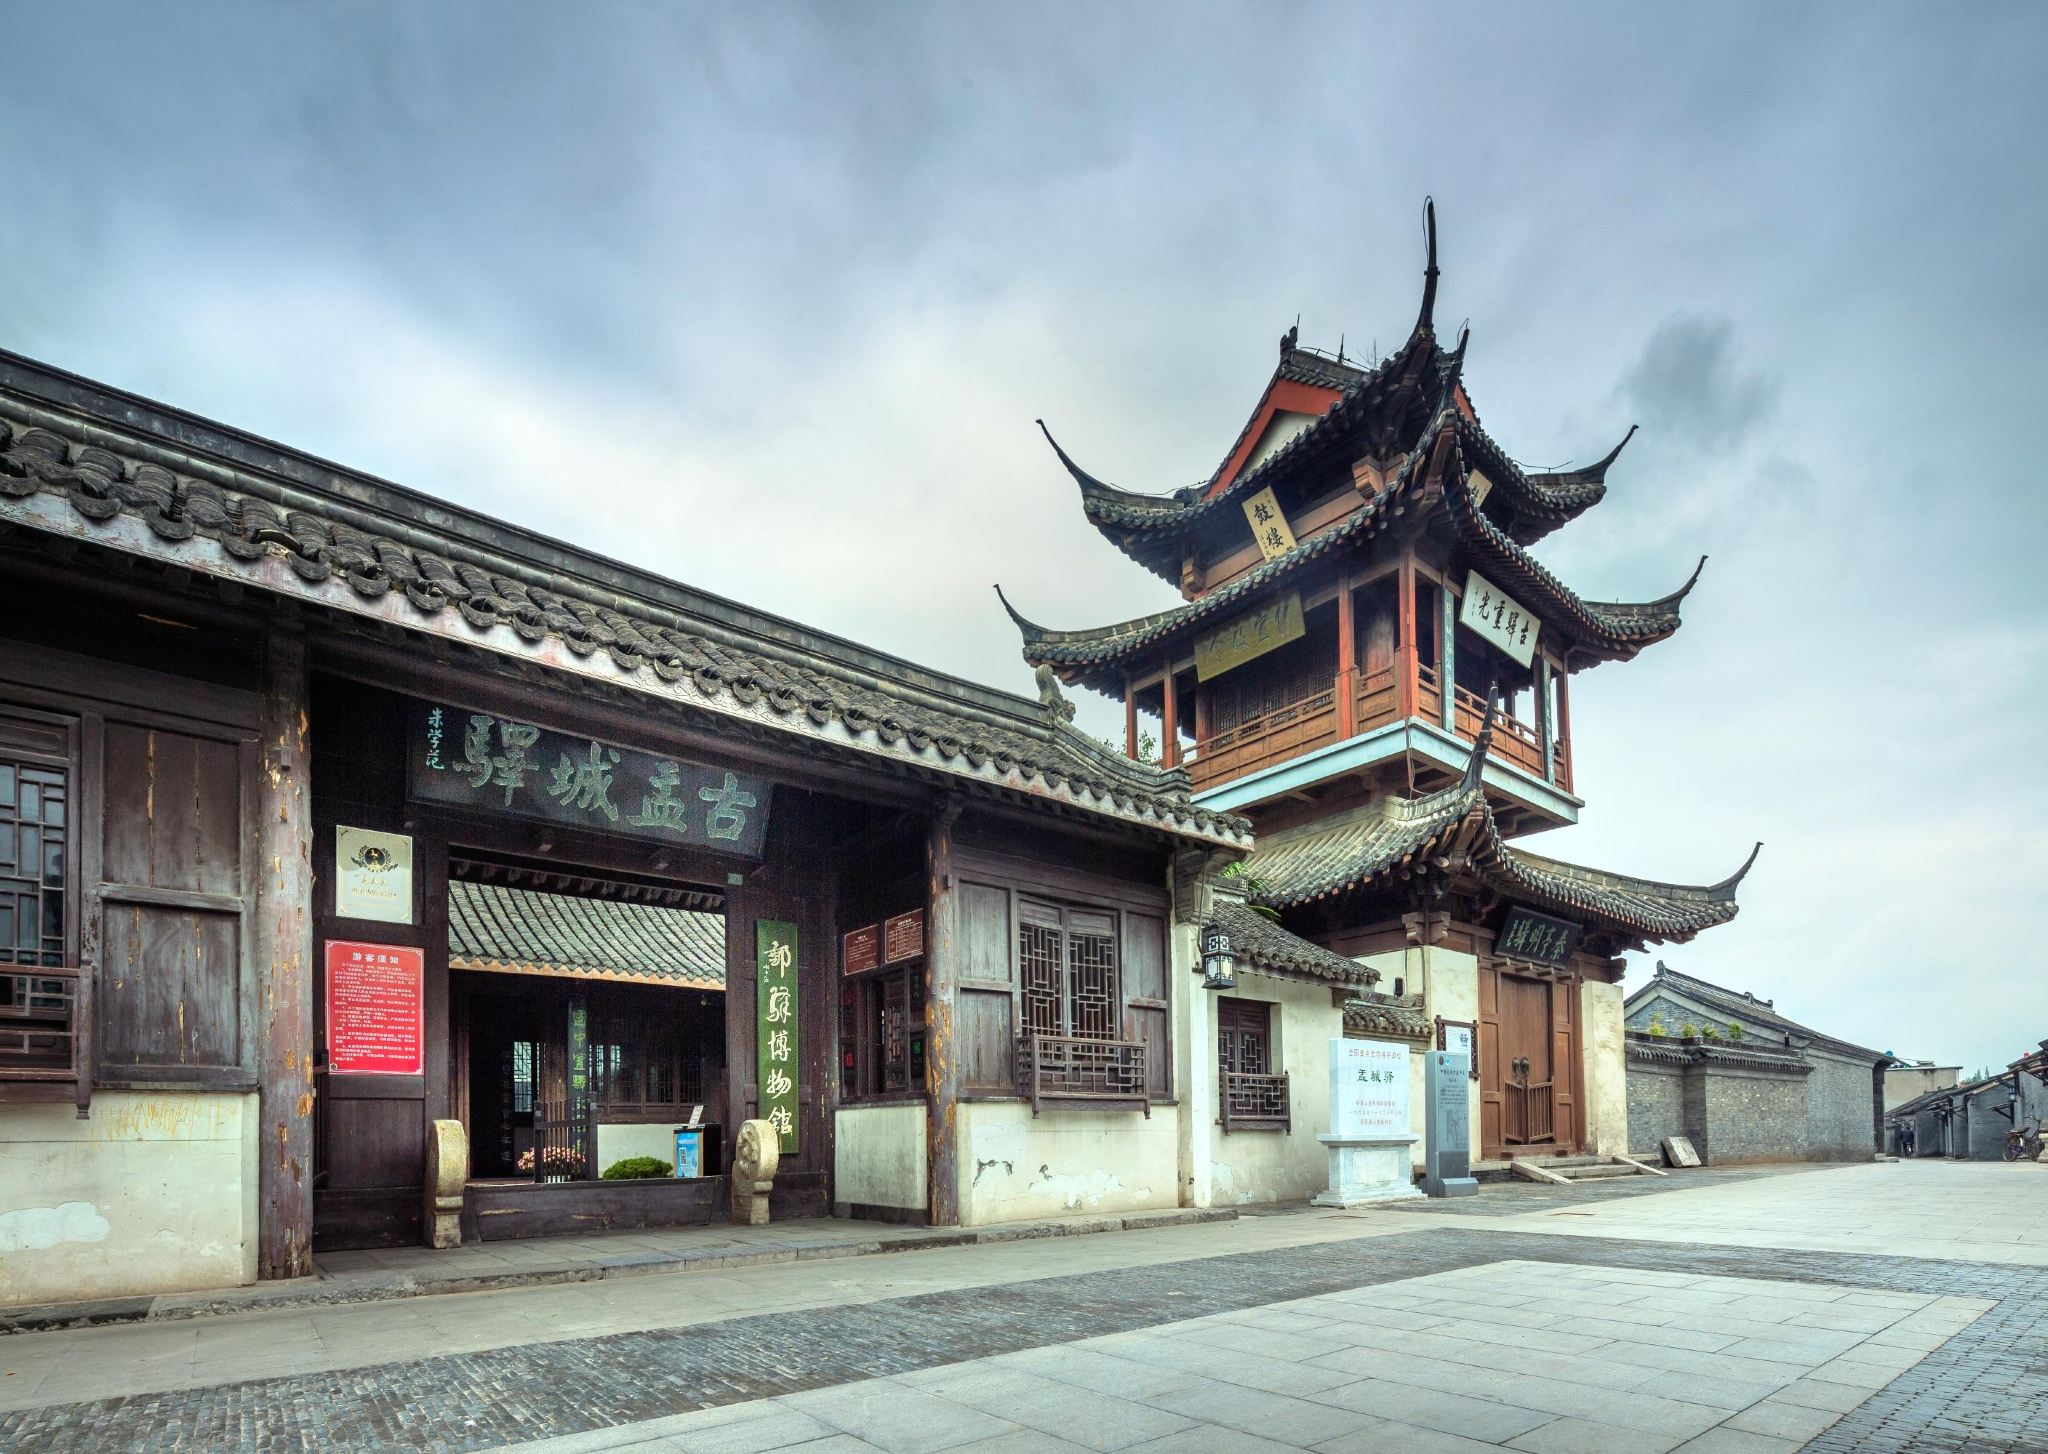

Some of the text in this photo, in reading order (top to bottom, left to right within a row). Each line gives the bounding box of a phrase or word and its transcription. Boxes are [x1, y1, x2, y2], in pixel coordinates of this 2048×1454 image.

[352, 952, 399, 964] 游客须知
[1357, 1069, 1395, 1083] 盂城驿
